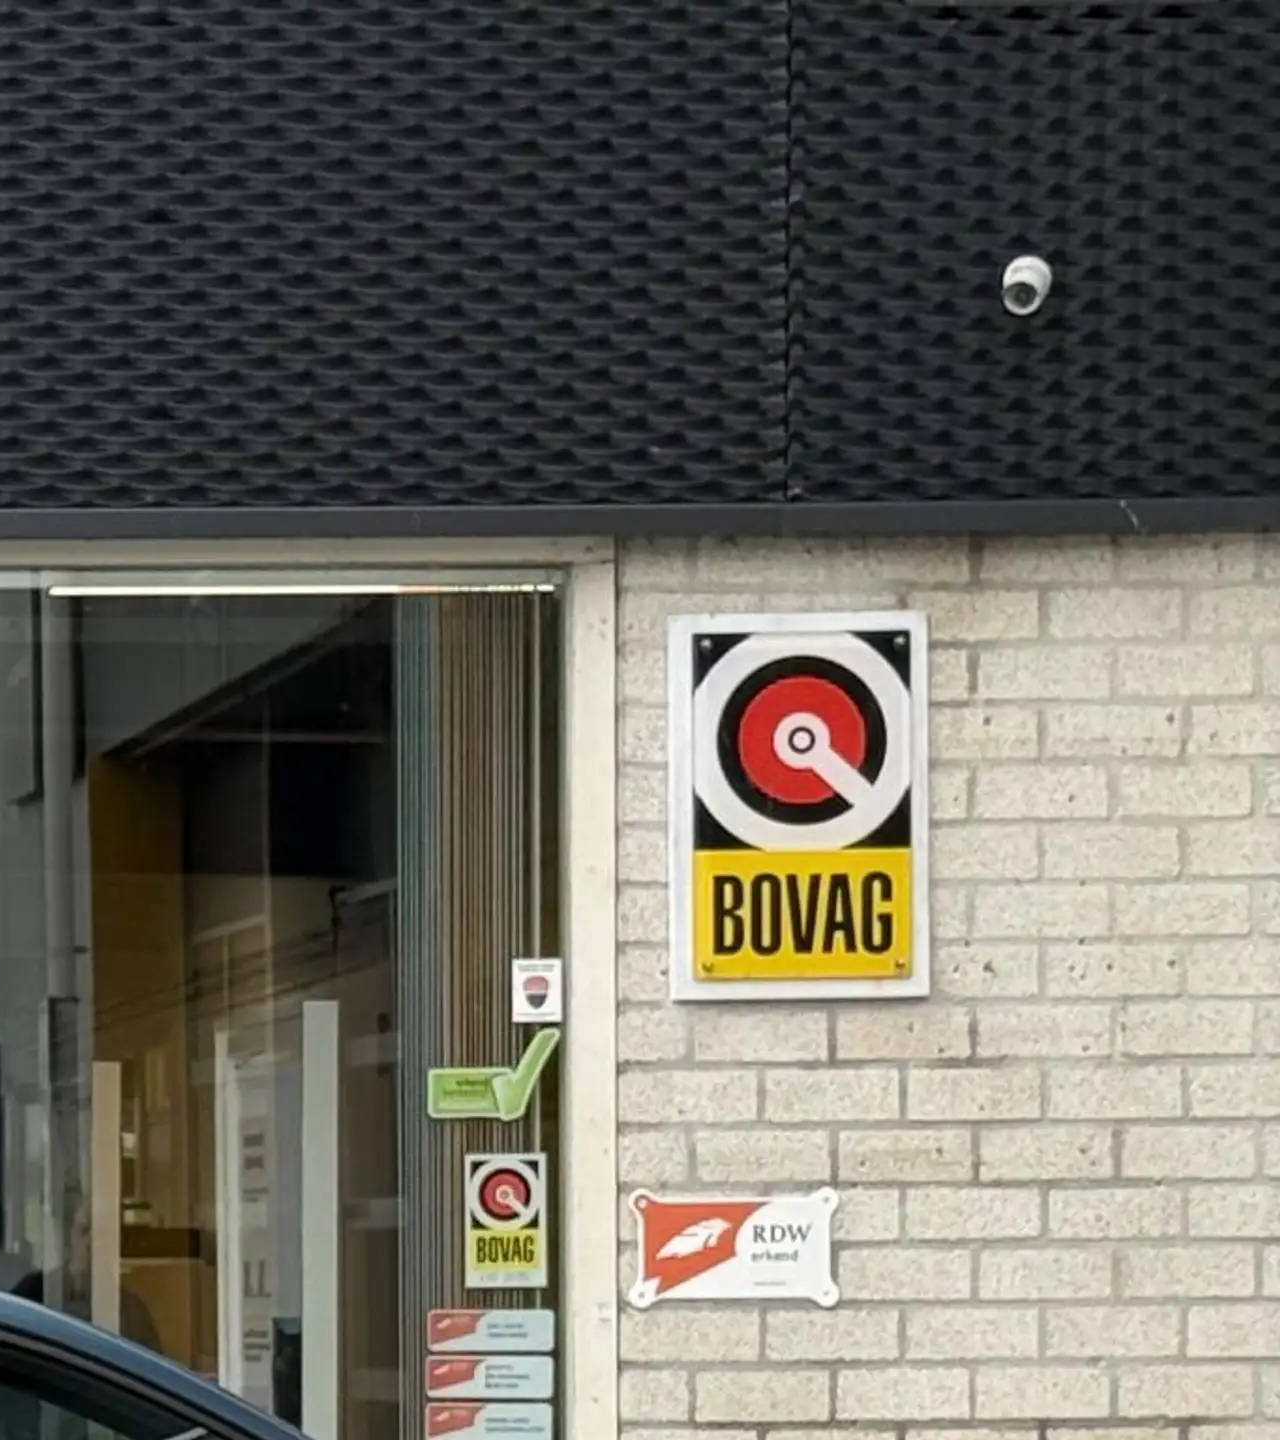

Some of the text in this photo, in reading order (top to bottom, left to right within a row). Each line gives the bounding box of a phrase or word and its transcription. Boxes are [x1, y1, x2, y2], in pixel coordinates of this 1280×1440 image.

[712, 871, 894, 956] BOVAG
[752, 1221, 813, 1244] RDW
[475, 1235, 535, 1263] BOVAG
